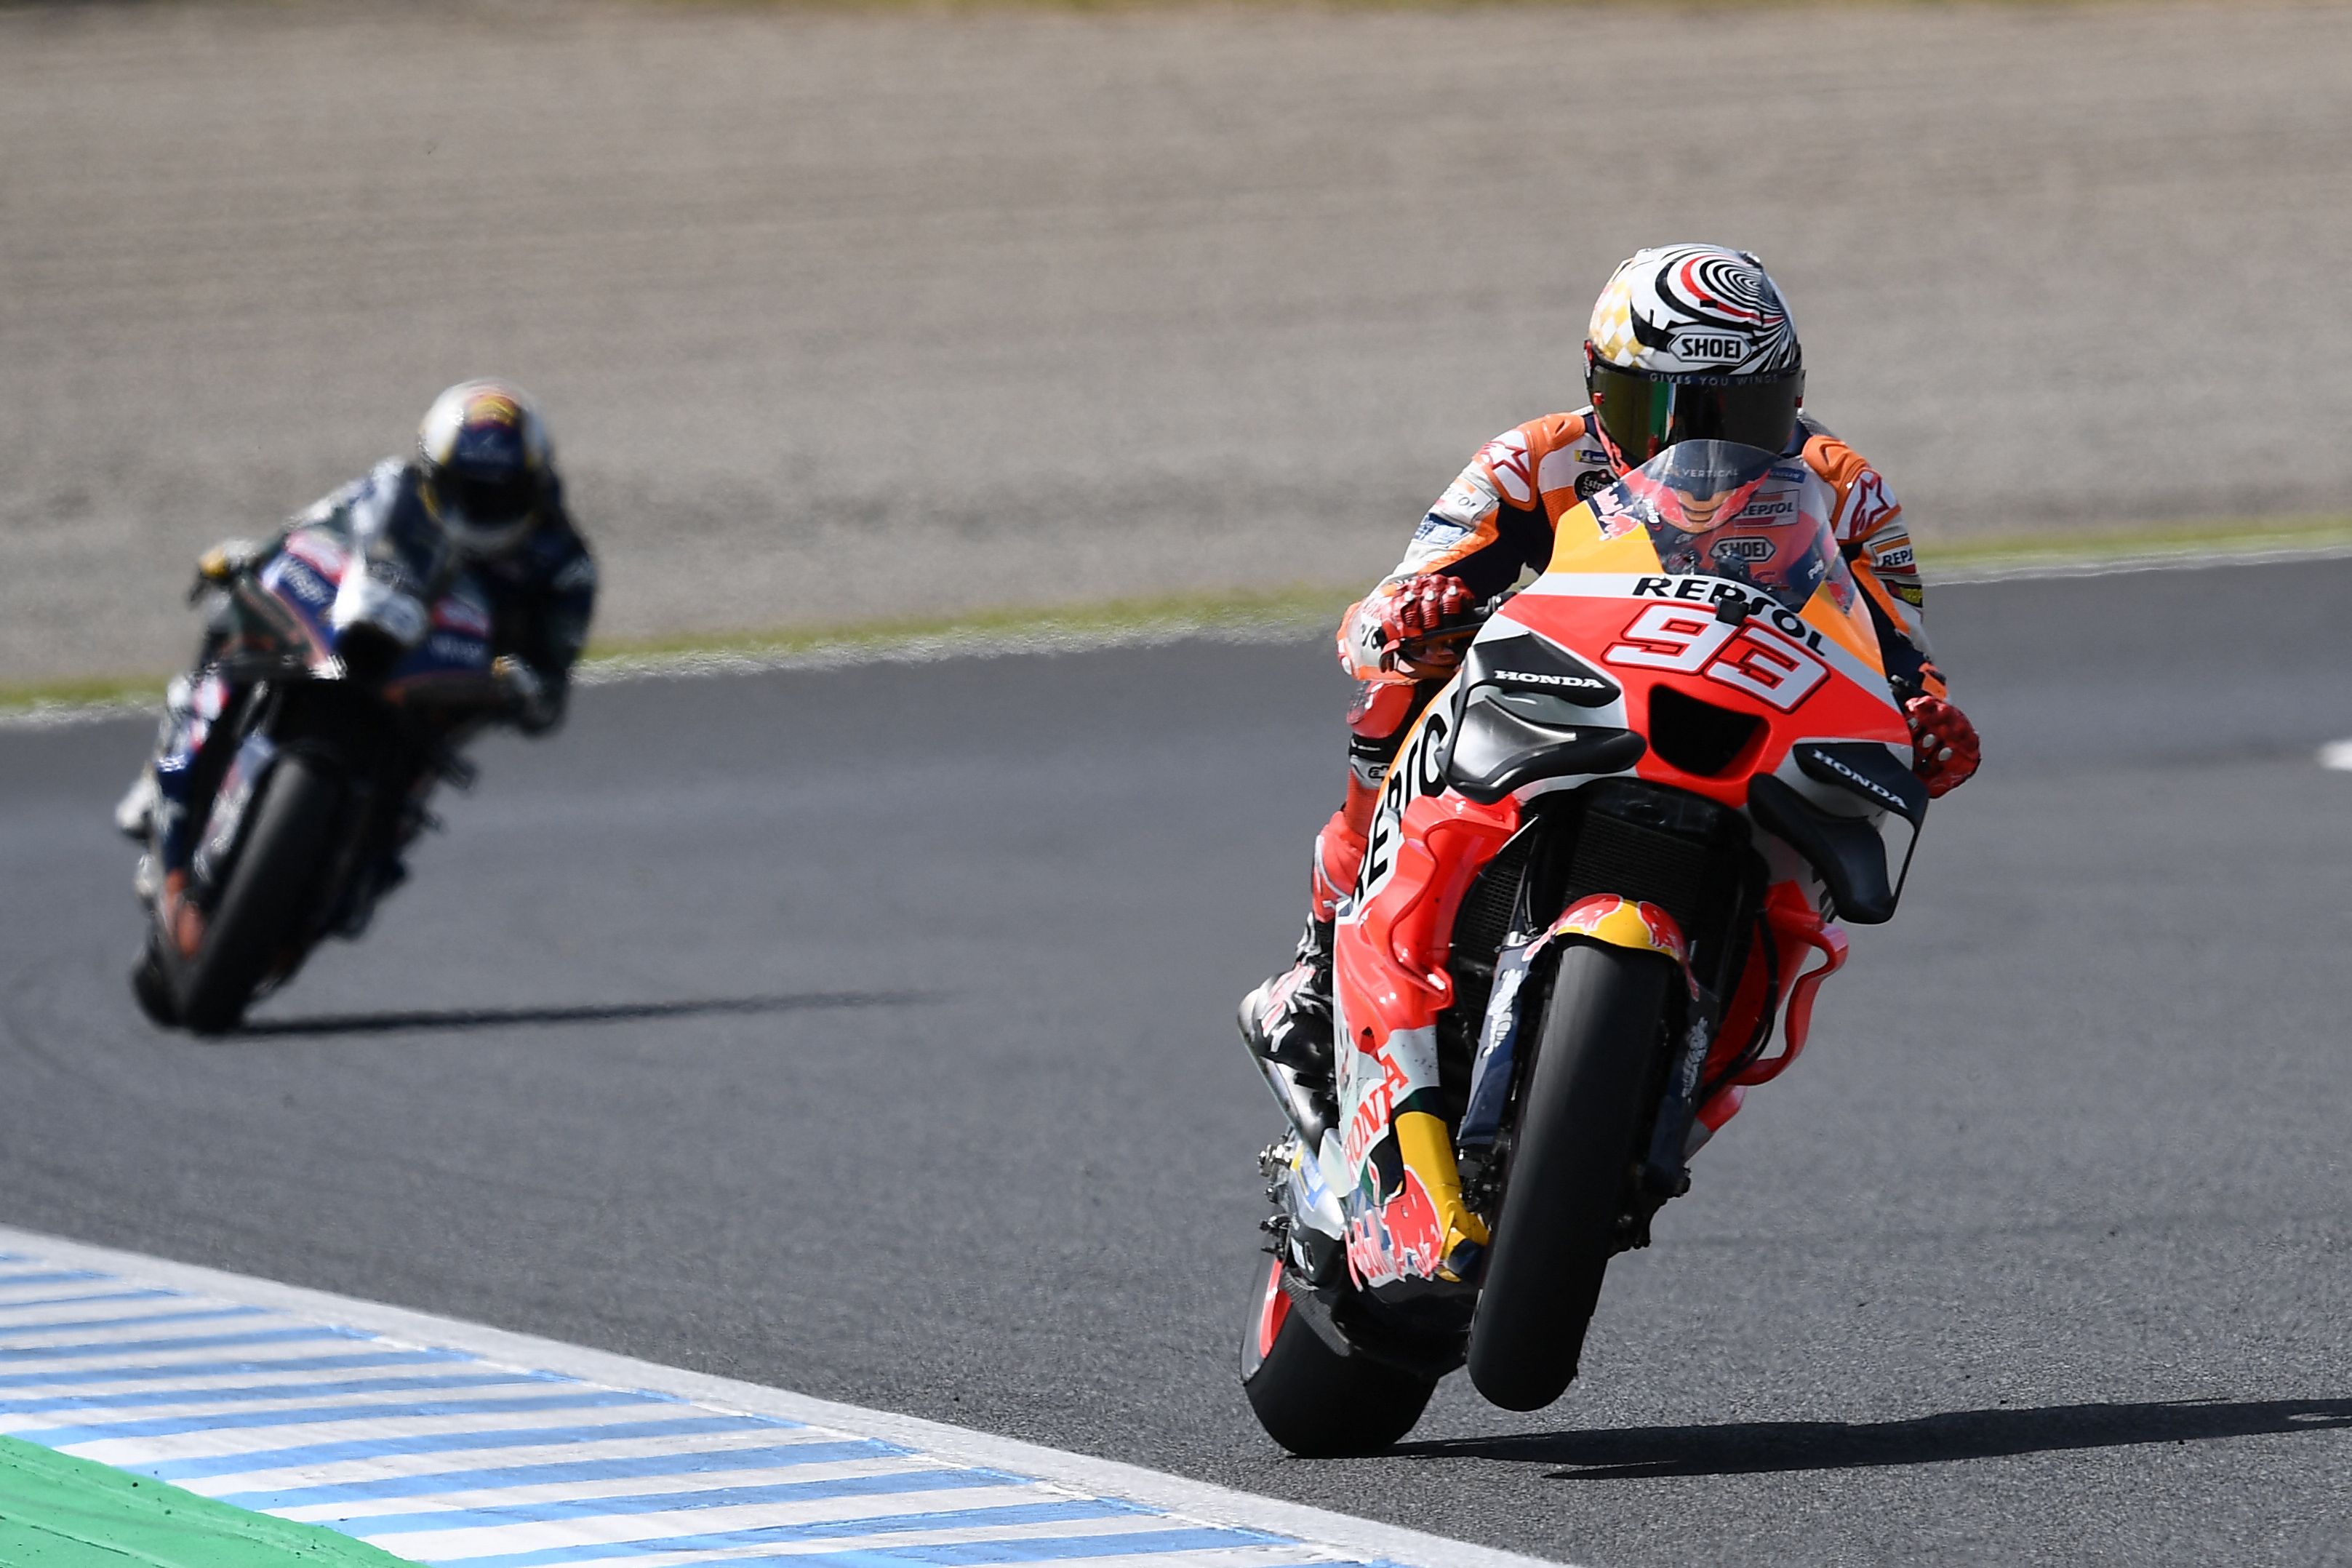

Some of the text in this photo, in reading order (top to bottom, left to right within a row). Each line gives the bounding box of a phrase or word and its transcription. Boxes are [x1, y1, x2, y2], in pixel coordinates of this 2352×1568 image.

[1681, 338, 1741, 359] SHOEI
[1649, 372, 1777, 386] GIVES YOU WINGS
[1683, 468, 1739, 478] VERTICAL
[1632, 577, 1826, 657] REPSOL
[1603, 602, 1830, 713] 93
[1494, 669, 1606, 689] HONDA
[1812, 748, 1909, 810] HONDA
